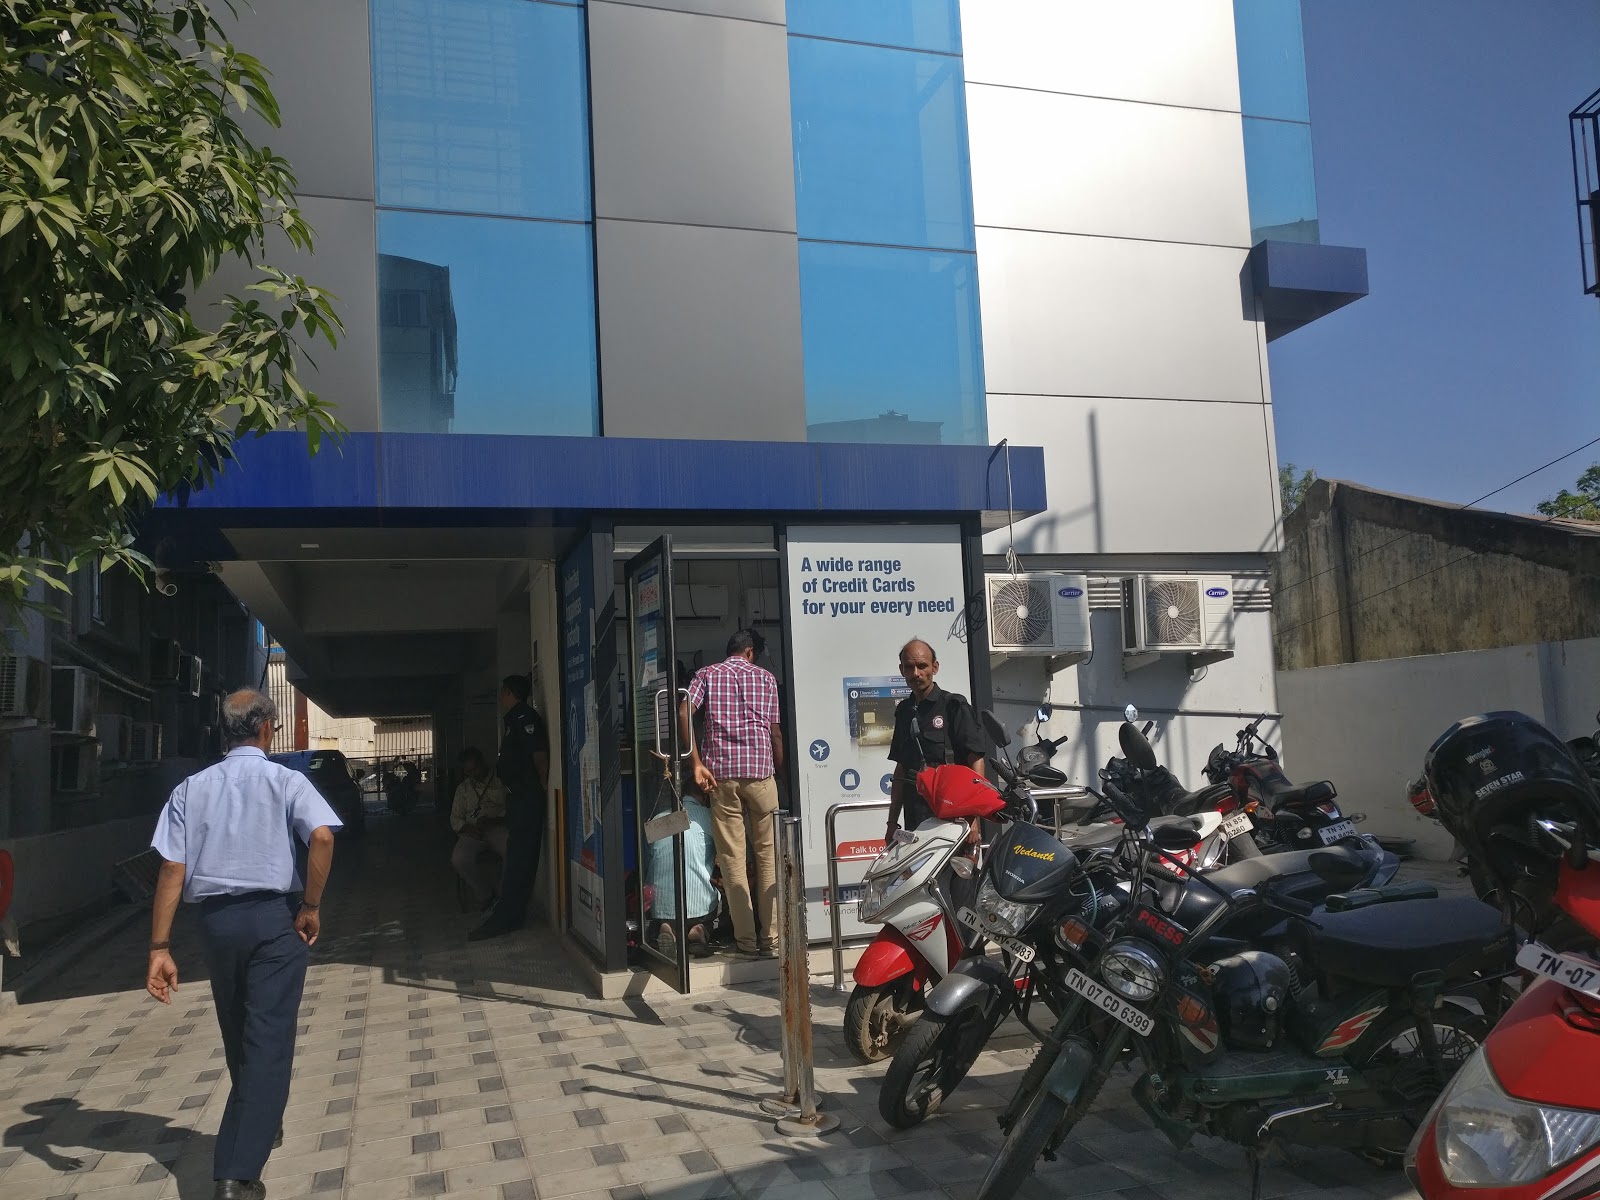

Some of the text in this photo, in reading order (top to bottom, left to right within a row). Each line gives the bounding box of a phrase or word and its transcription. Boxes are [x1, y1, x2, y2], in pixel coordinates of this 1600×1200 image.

[801, 557, 901, 575] A wide range
[802, 577, 916, 593] of Credit Cards
[1060, 589, 1081, 597] Carrier
[1207, 589, 1227, 597] Carrier
[802, 597, 955, 617] for your every need
[1475, 780, 1500, 798] SEVEN
[1500, 771, 1523, 784] STAR
[1326, 826, 1337, 835] TN
[850, 846, 867, 854] Talk
[869, 845, 877, 853] to
[1013, 844, 1055, 862] Vedanth
[1005, 870, 1025, 885] HONDA
[964, 912, 977, 926] TN
[1010, 942, 1032, 960] 4483
[1138, 909, 1184, 945] PRESS
[1536, 953, 1596, 988] TN 07
[1069, 972, 1150, 1032] TN 07 CD 6399
[1325, 1069, 1348, 1081] XL
